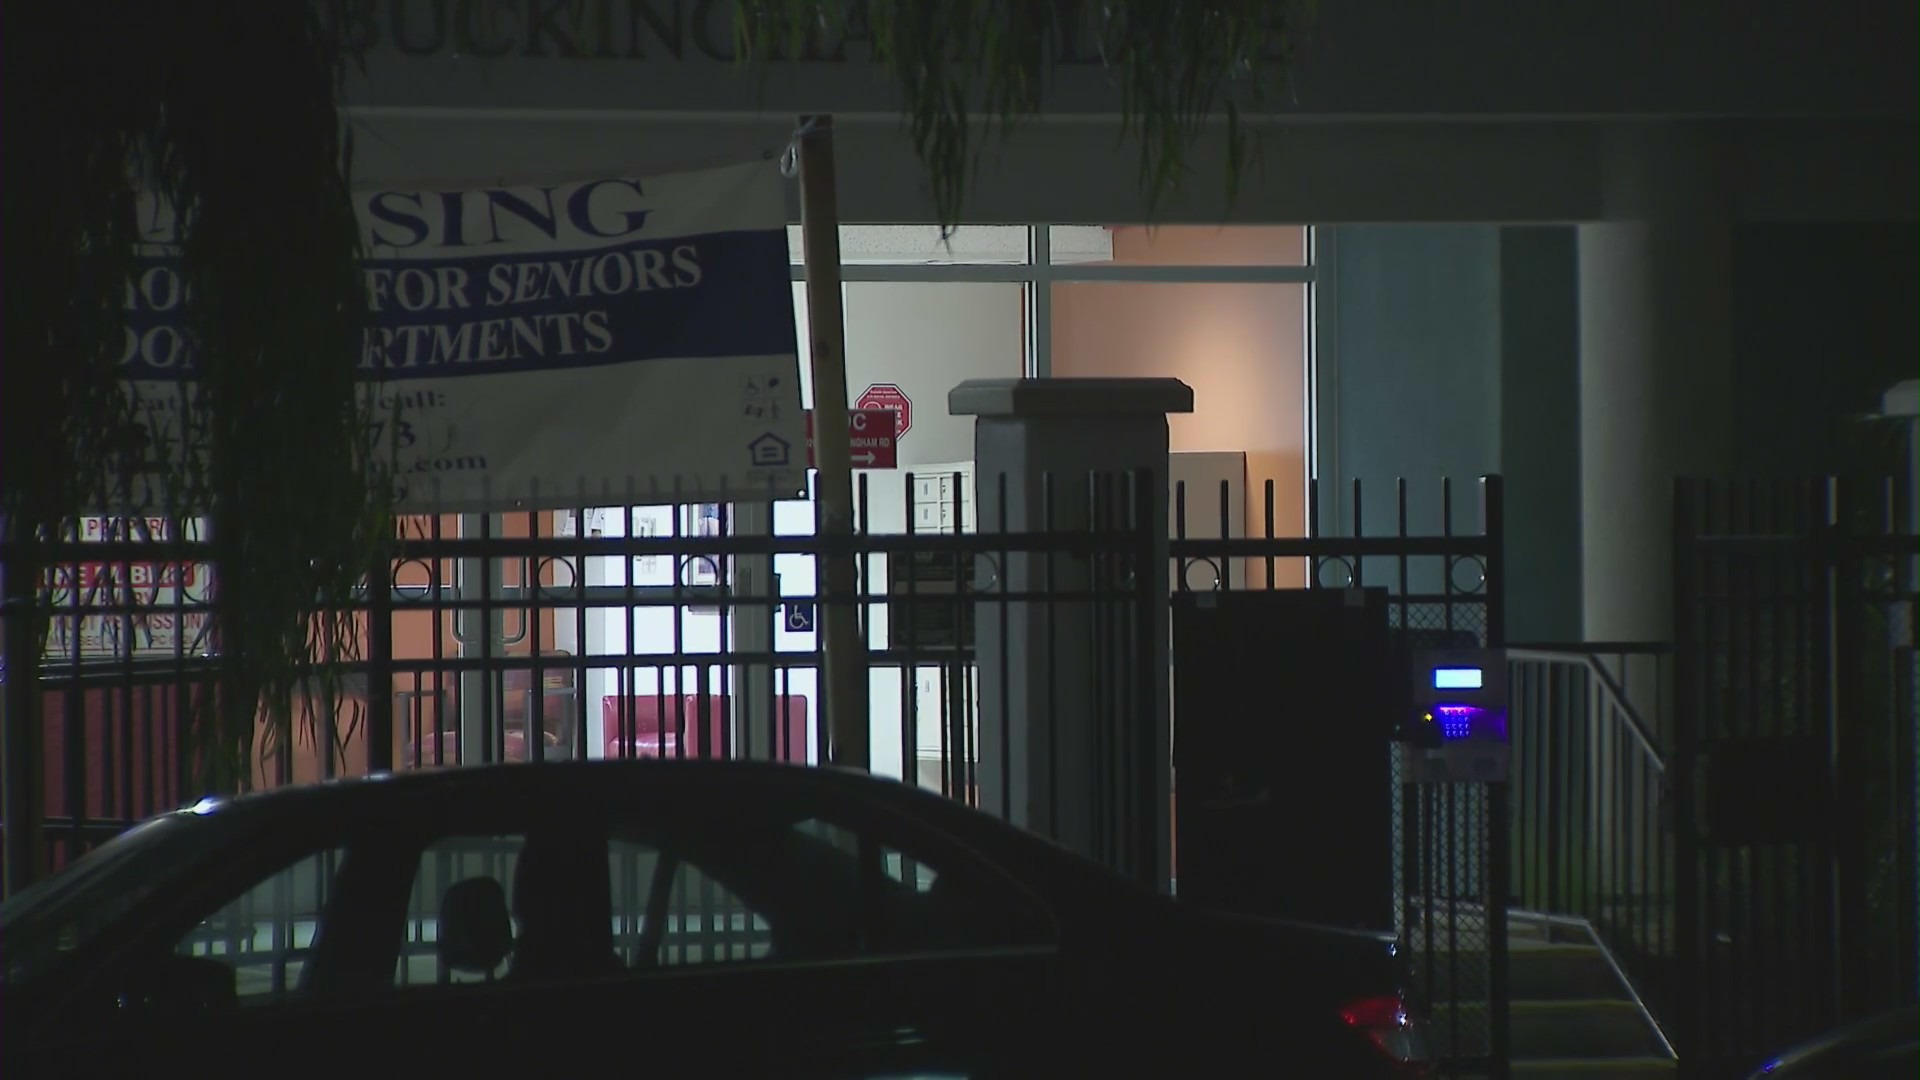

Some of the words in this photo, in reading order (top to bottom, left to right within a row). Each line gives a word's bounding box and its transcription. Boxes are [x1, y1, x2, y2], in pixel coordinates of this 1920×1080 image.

[369, 178, 656, 248] SING
[364, 262, 471, 312] FOR
[485, 244, 702, 308] SENIORS
[357, 310, 613, 370] RTMENTS
